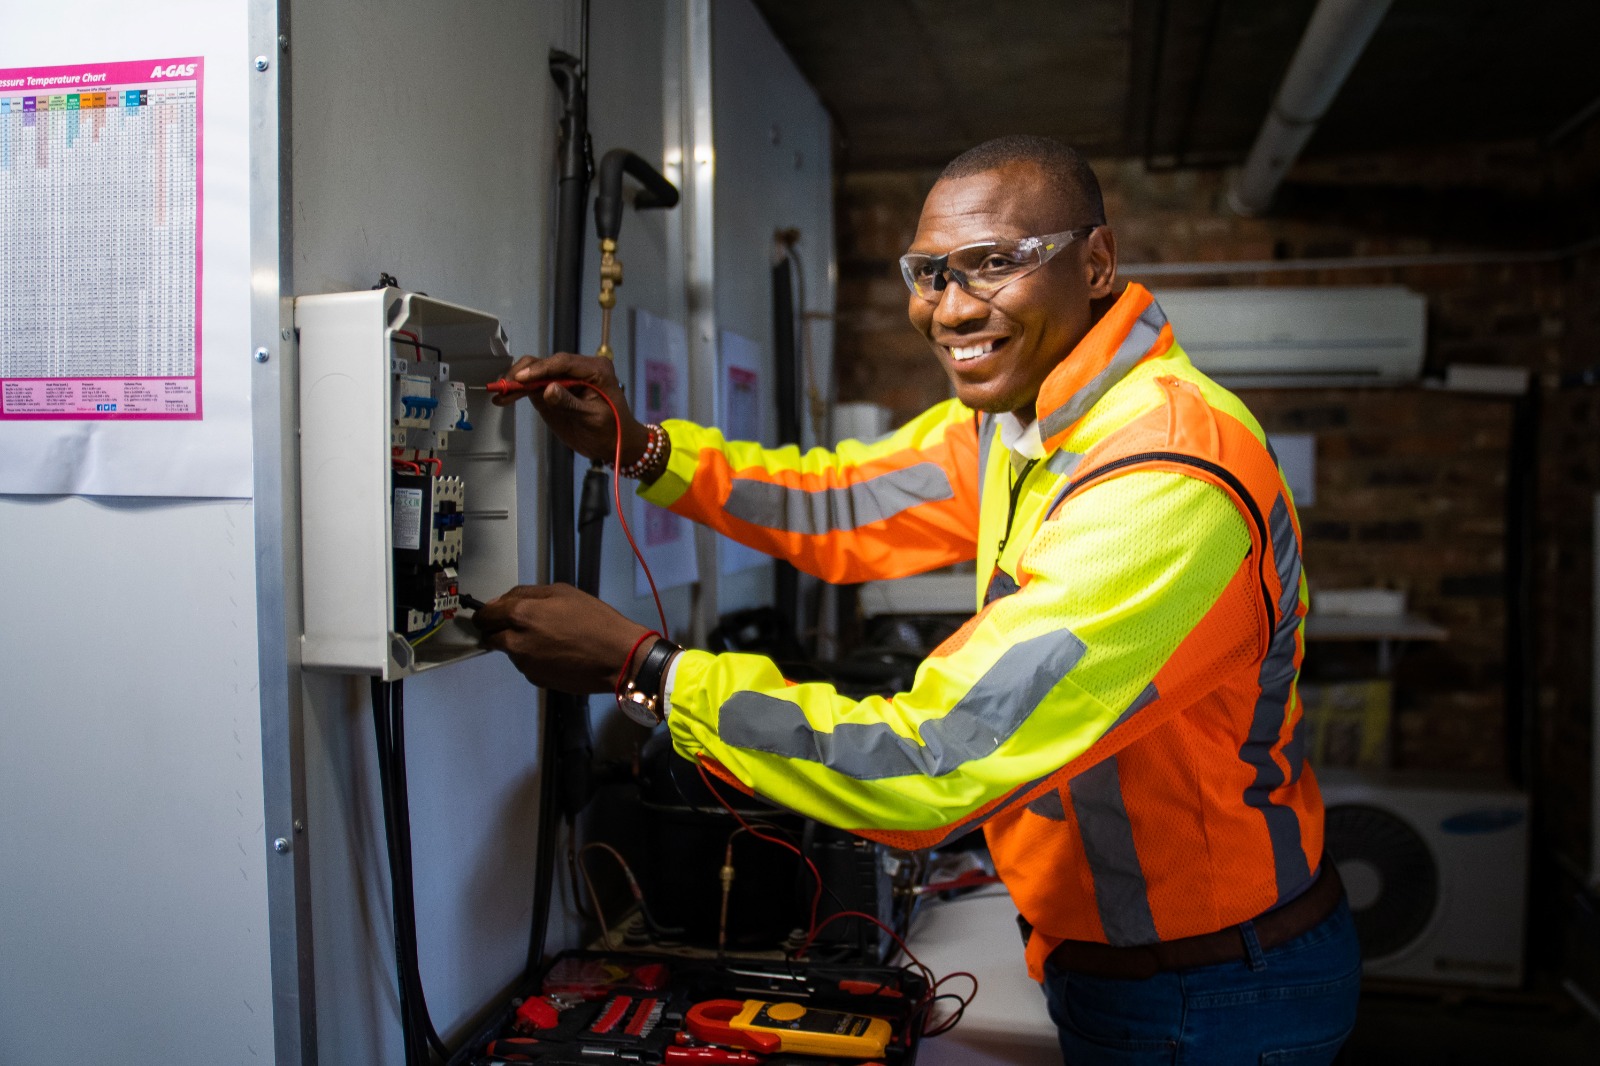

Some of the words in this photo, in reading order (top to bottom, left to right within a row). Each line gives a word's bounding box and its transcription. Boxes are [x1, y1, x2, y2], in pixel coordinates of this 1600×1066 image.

[150, 64, 197, 79] A-GAS
[26, 75, 80, 87] Temperature
[82, 72, 106, 83] Chart
